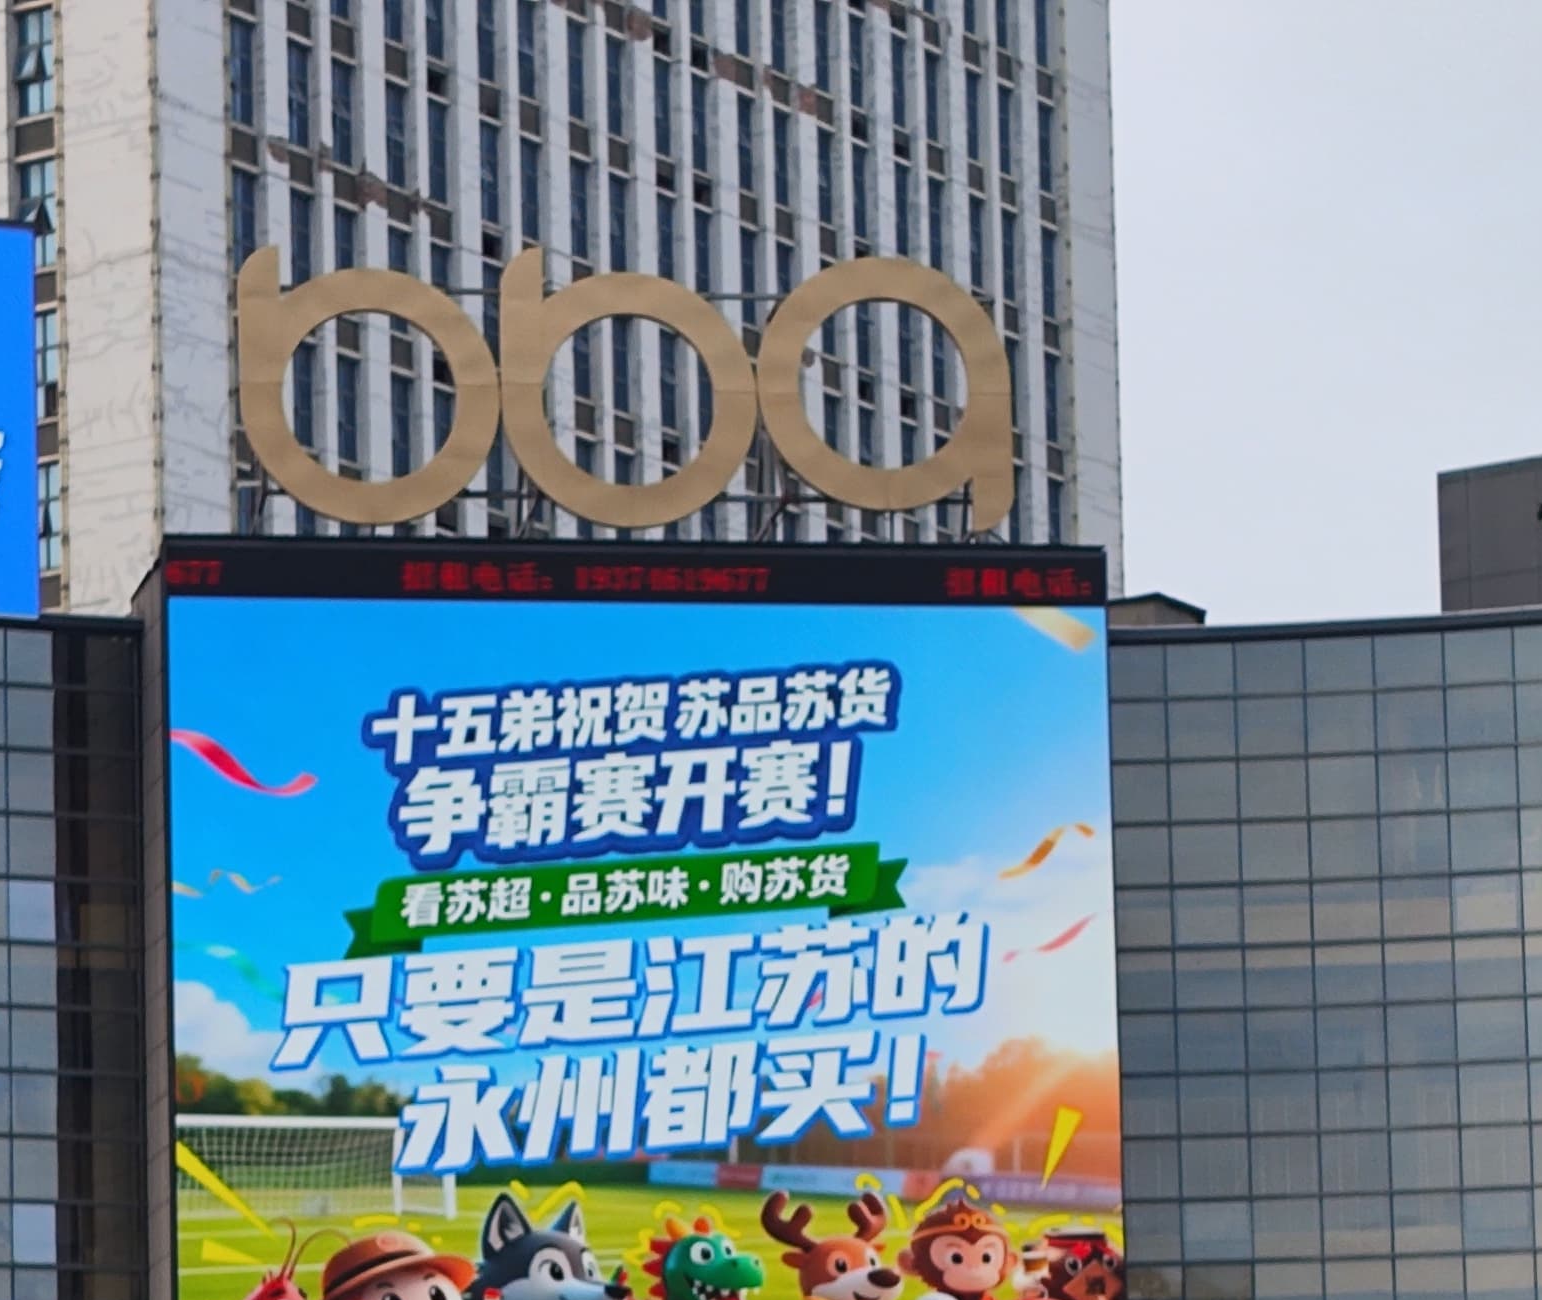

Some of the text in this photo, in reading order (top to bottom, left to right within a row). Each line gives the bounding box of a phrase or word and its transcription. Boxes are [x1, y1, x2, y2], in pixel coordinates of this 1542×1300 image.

[272, 912, 990, 1069] 只要是江苏的
